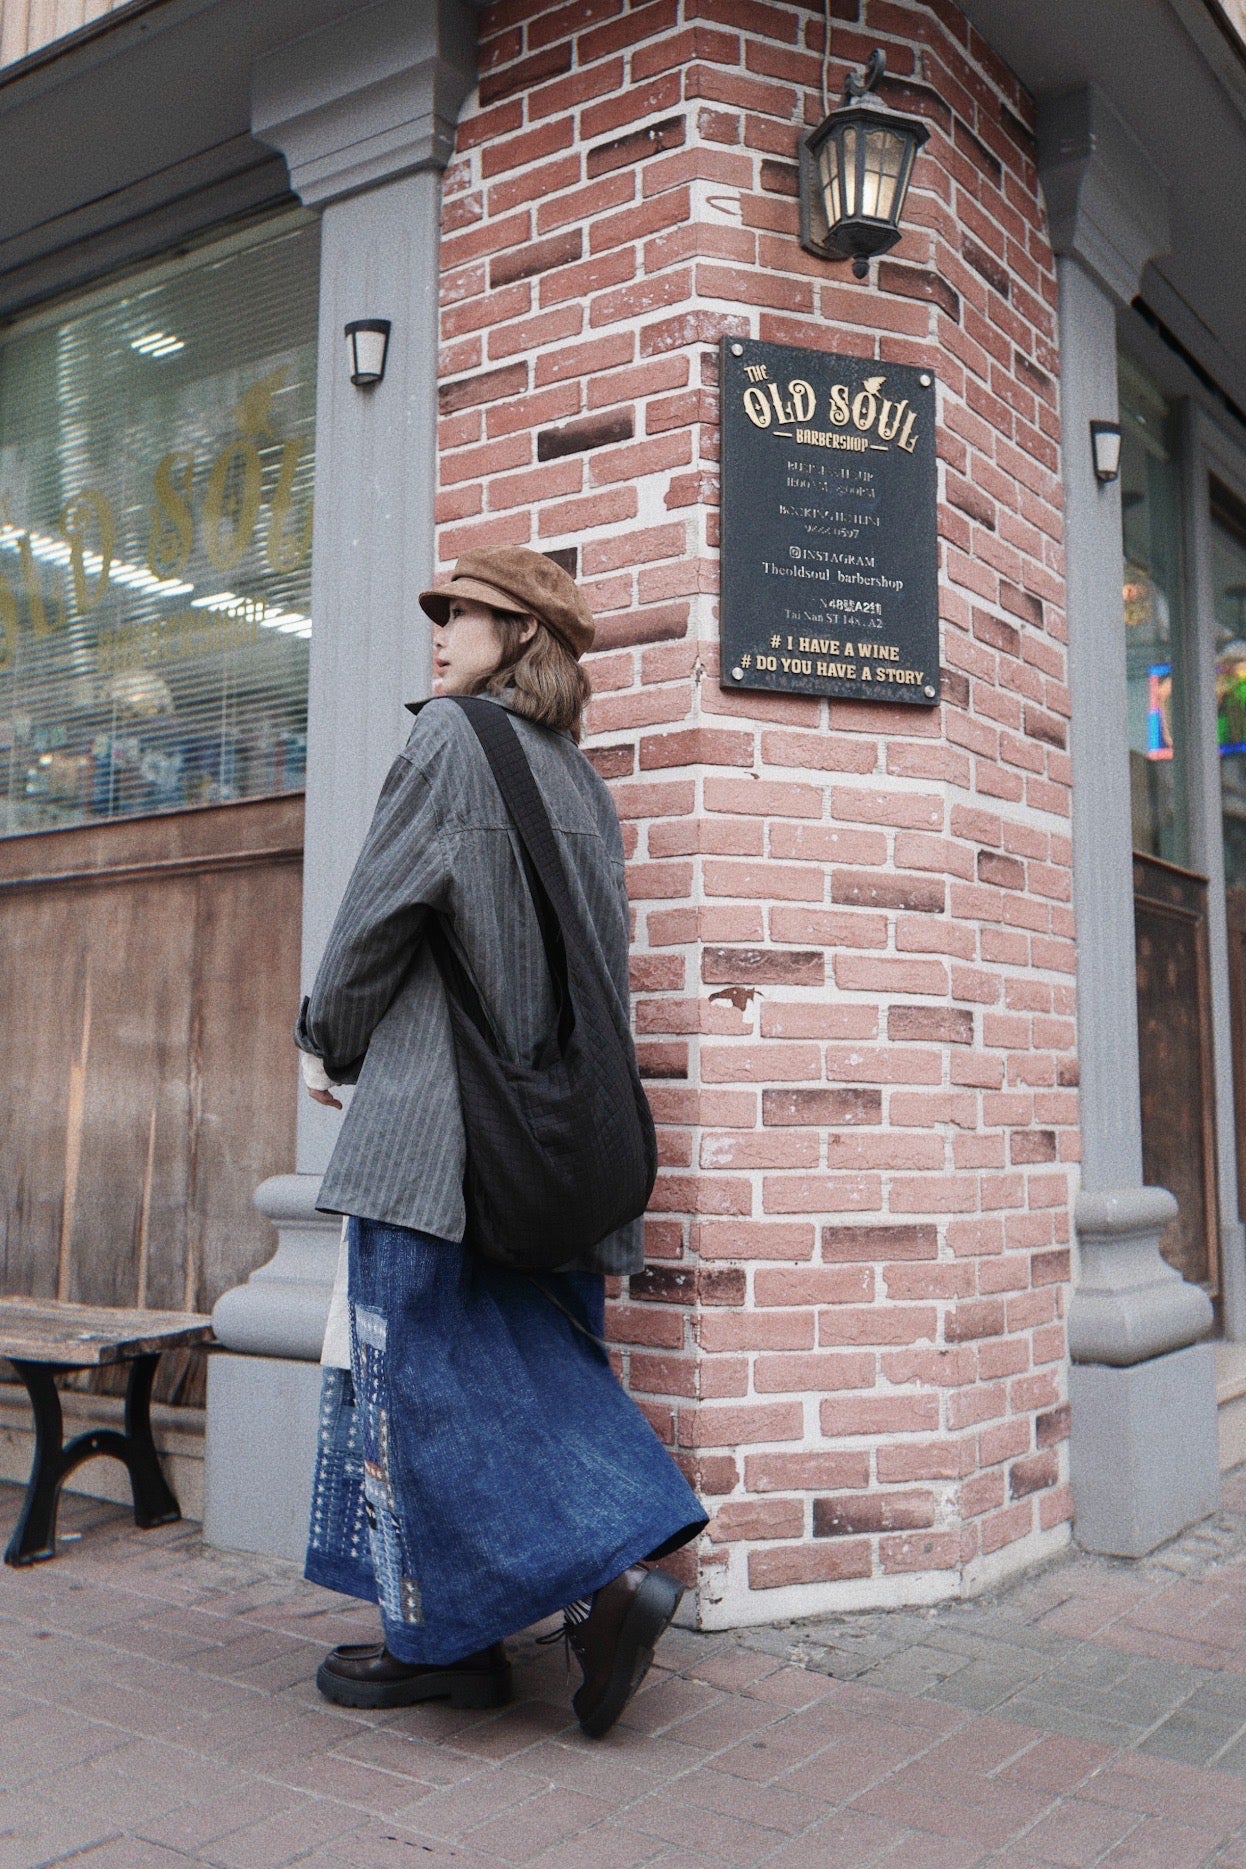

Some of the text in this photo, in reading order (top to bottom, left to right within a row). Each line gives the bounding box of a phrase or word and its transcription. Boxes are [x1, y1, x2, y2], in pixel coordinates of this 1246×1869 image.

[743, 364, 769, 383] THE
[743, 379, 919, 454] OLD SOUL
[796, 428, 868, 453] BARBERSHOP
[147, 437, 312, 581] SOU
[803, 549, 875, 568] INSTAGRAM
[784, 609, 801, 620] Tai
[868, 618, 883, 629] A2
[770, 634, 900, 662] # I HAVE A WINE
[740, 654, 925, 686] # DO YOU HAVE A STORY
